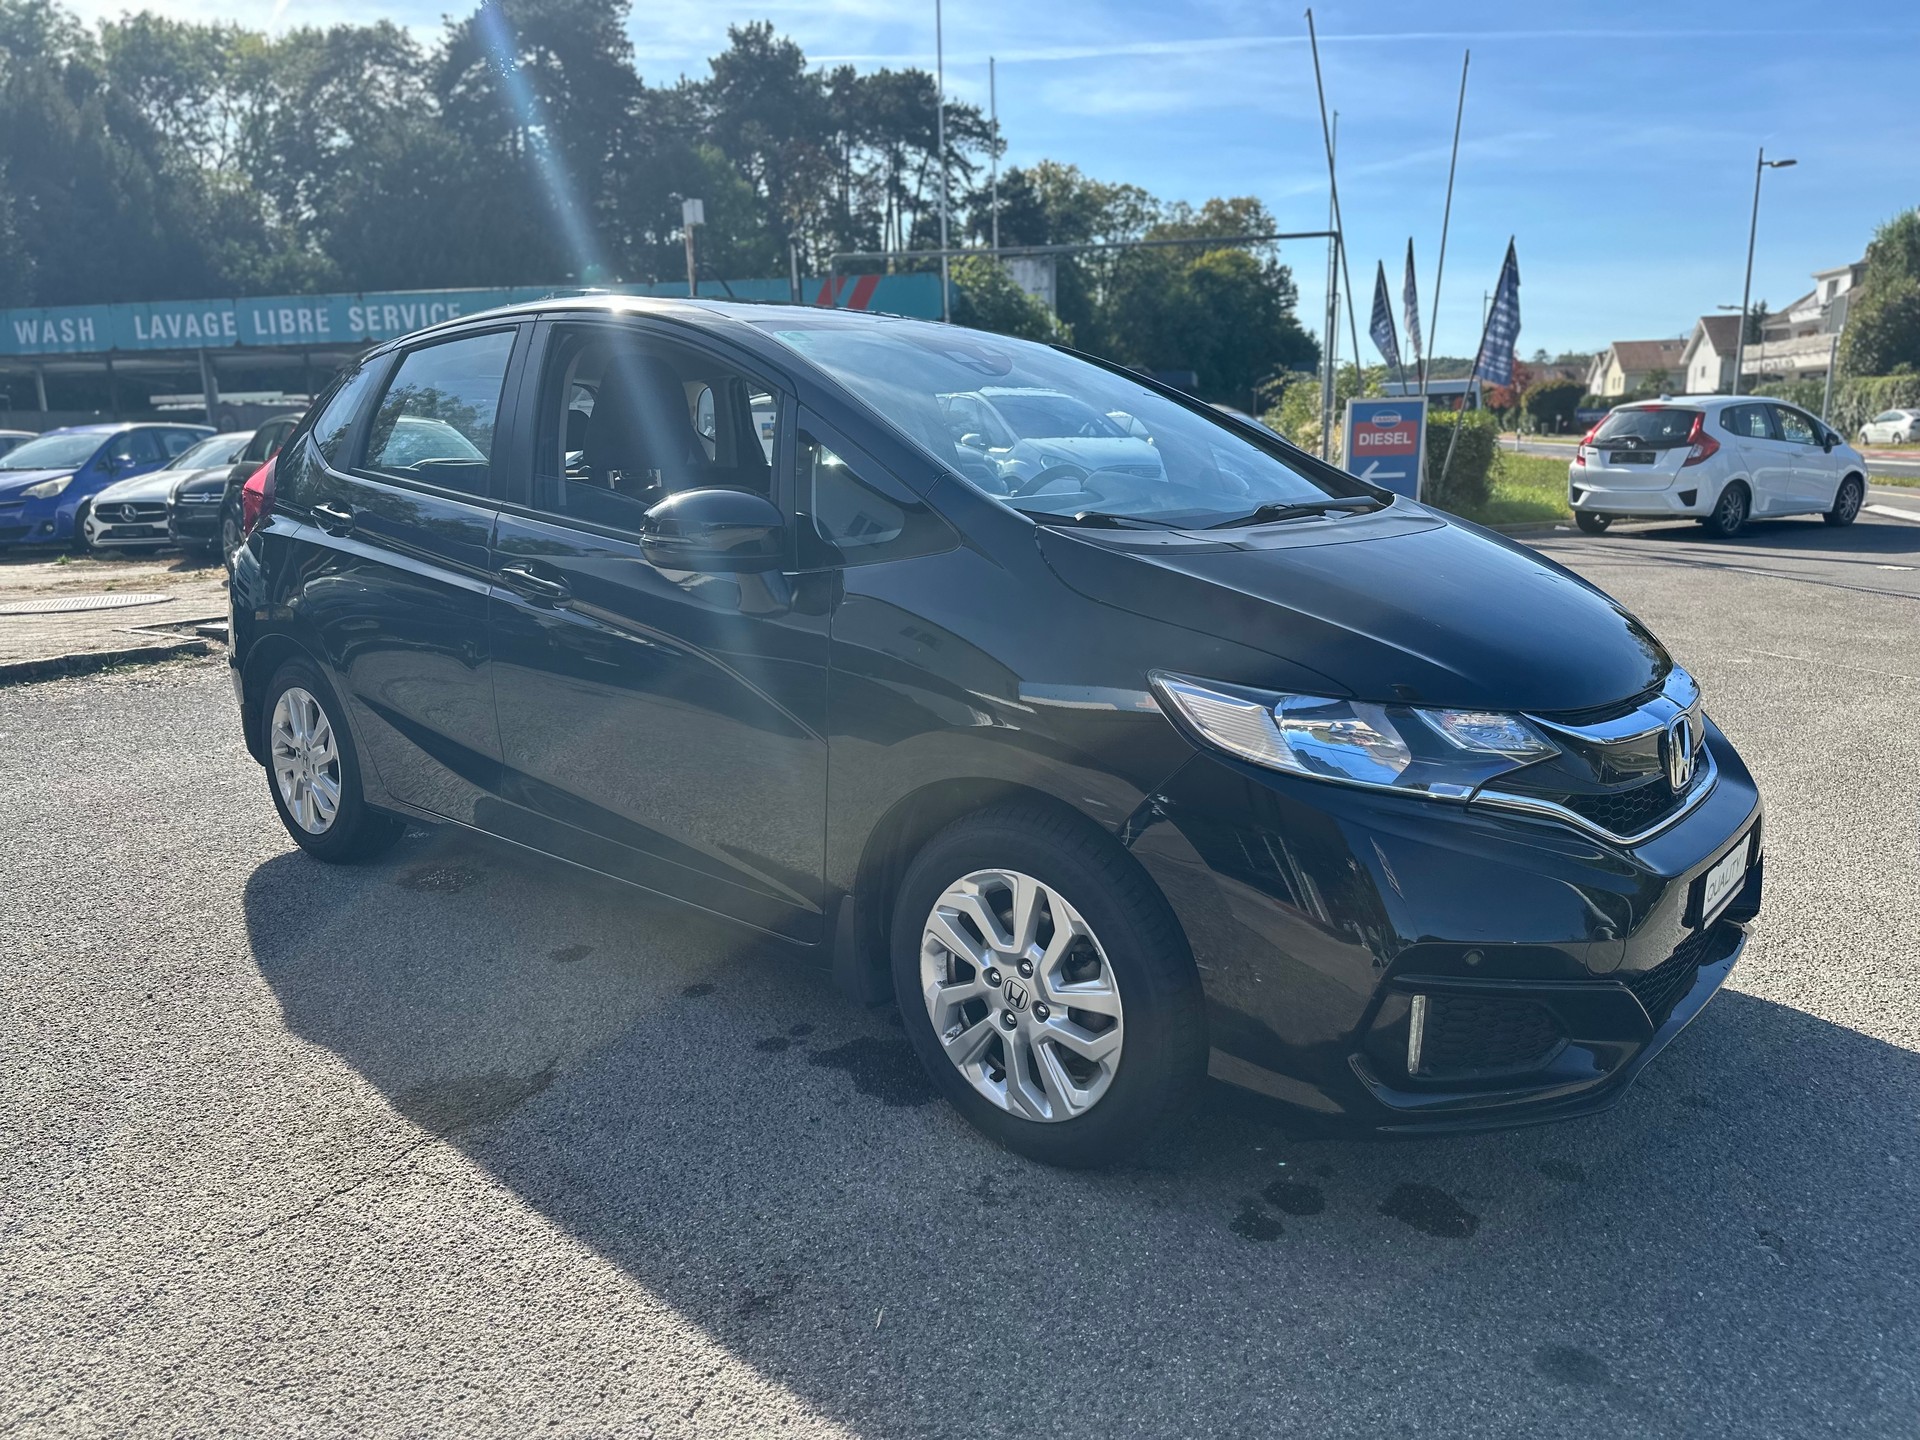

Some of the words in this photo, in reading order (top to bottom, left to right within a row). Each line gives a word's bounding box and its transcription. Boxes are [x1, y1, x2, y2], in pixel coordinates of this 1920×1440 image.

[14, 317, 96, 345] WASH
[134, 312, 237, 340] LAVAGE
[253, 308, 330, 335] LIBRE
[348, 303, 461, 332] SERVICE
[1358, 432, 1412, 446] DIESEL
